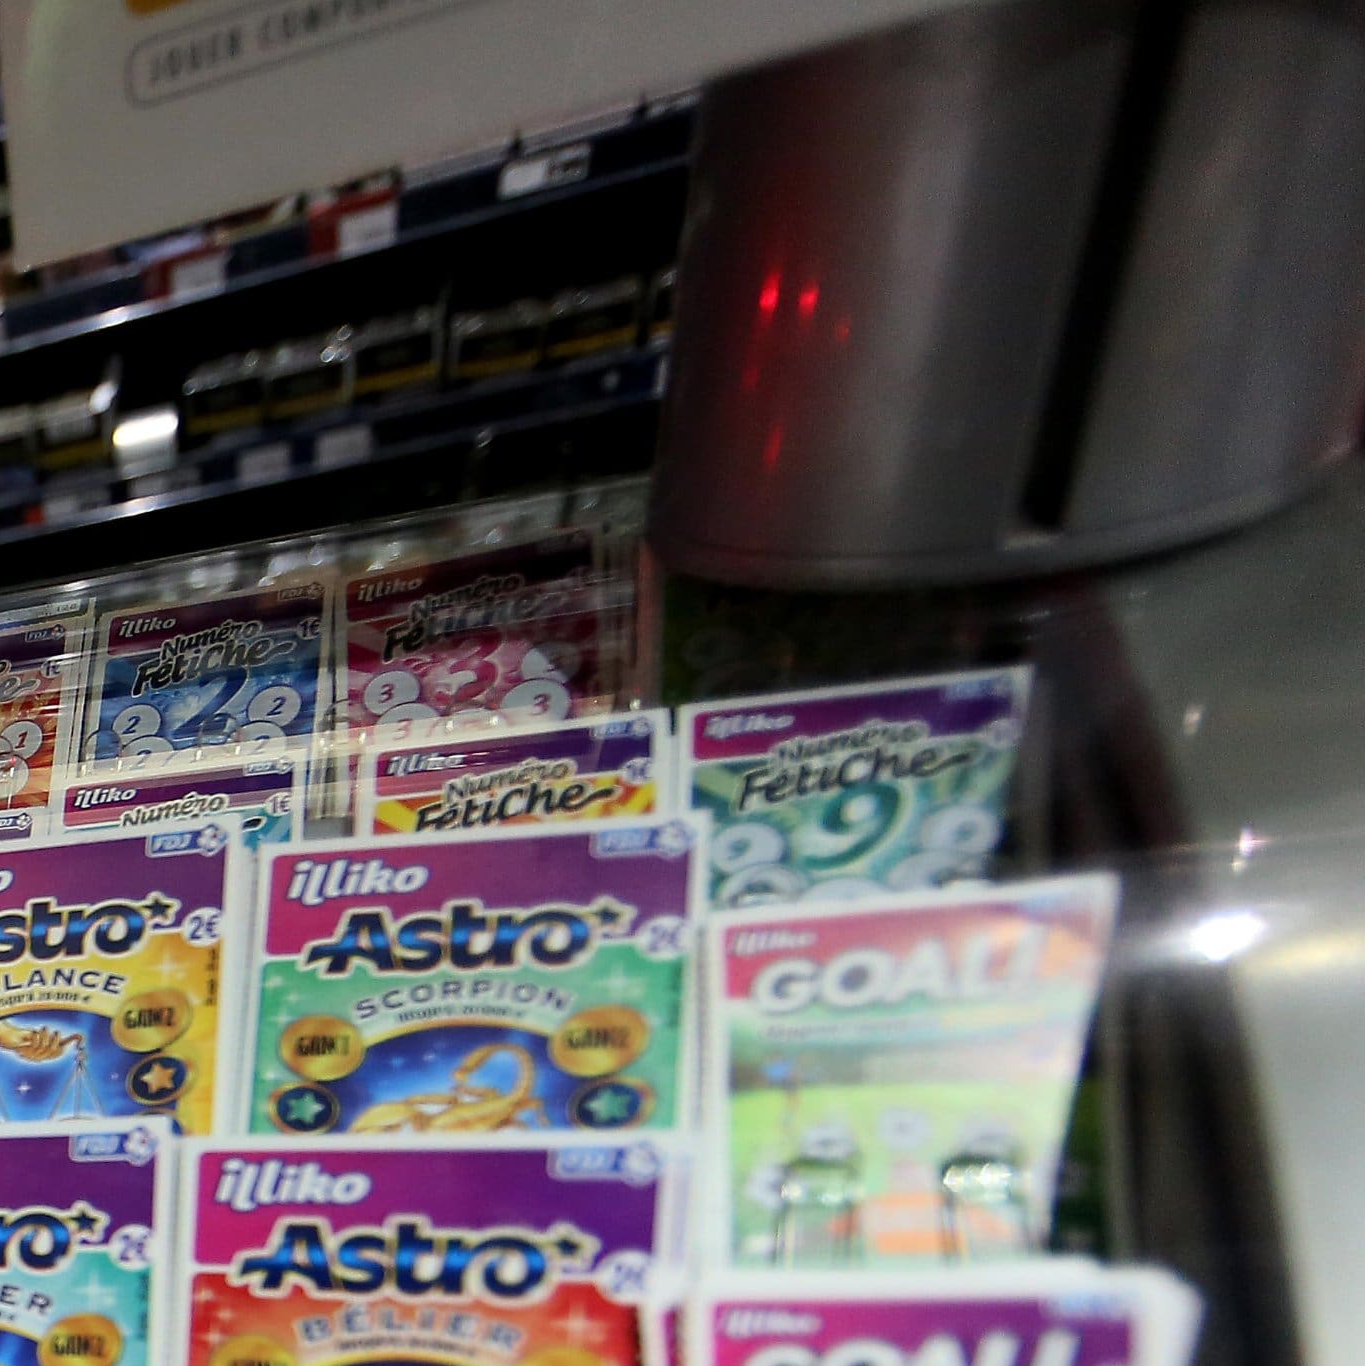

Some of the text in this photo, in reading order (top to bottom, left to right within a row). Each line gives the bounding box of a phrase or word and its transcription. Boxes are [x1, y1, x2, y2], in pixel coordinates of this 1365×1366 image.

[120, 616, 175, 638] illiko
[159, 622, 265, 661] Numéro
[132, 640, 297, 697] Fétiche
[74, 786, 136, 808] illiko
[445, 758, 577, 799] Numéro
[120, 793, 229, 828] Numéro
[416, 782, 619, 831] Fétiche
[797, 783, 907, 870] 9
[288, 859, 429, 905] illiko
[189, 915, 220, 942] 2€
[306, 904, 592, 974] Astro
[751, 924, 1049, 1014] GOAL!
[355, 978, 572, 1021] SCORPION
[215, 1158, 371, 1210] illiko
[239, 1222, 549, 1298] Astro
[299, 1306, 524, 1350] BÉLIER
